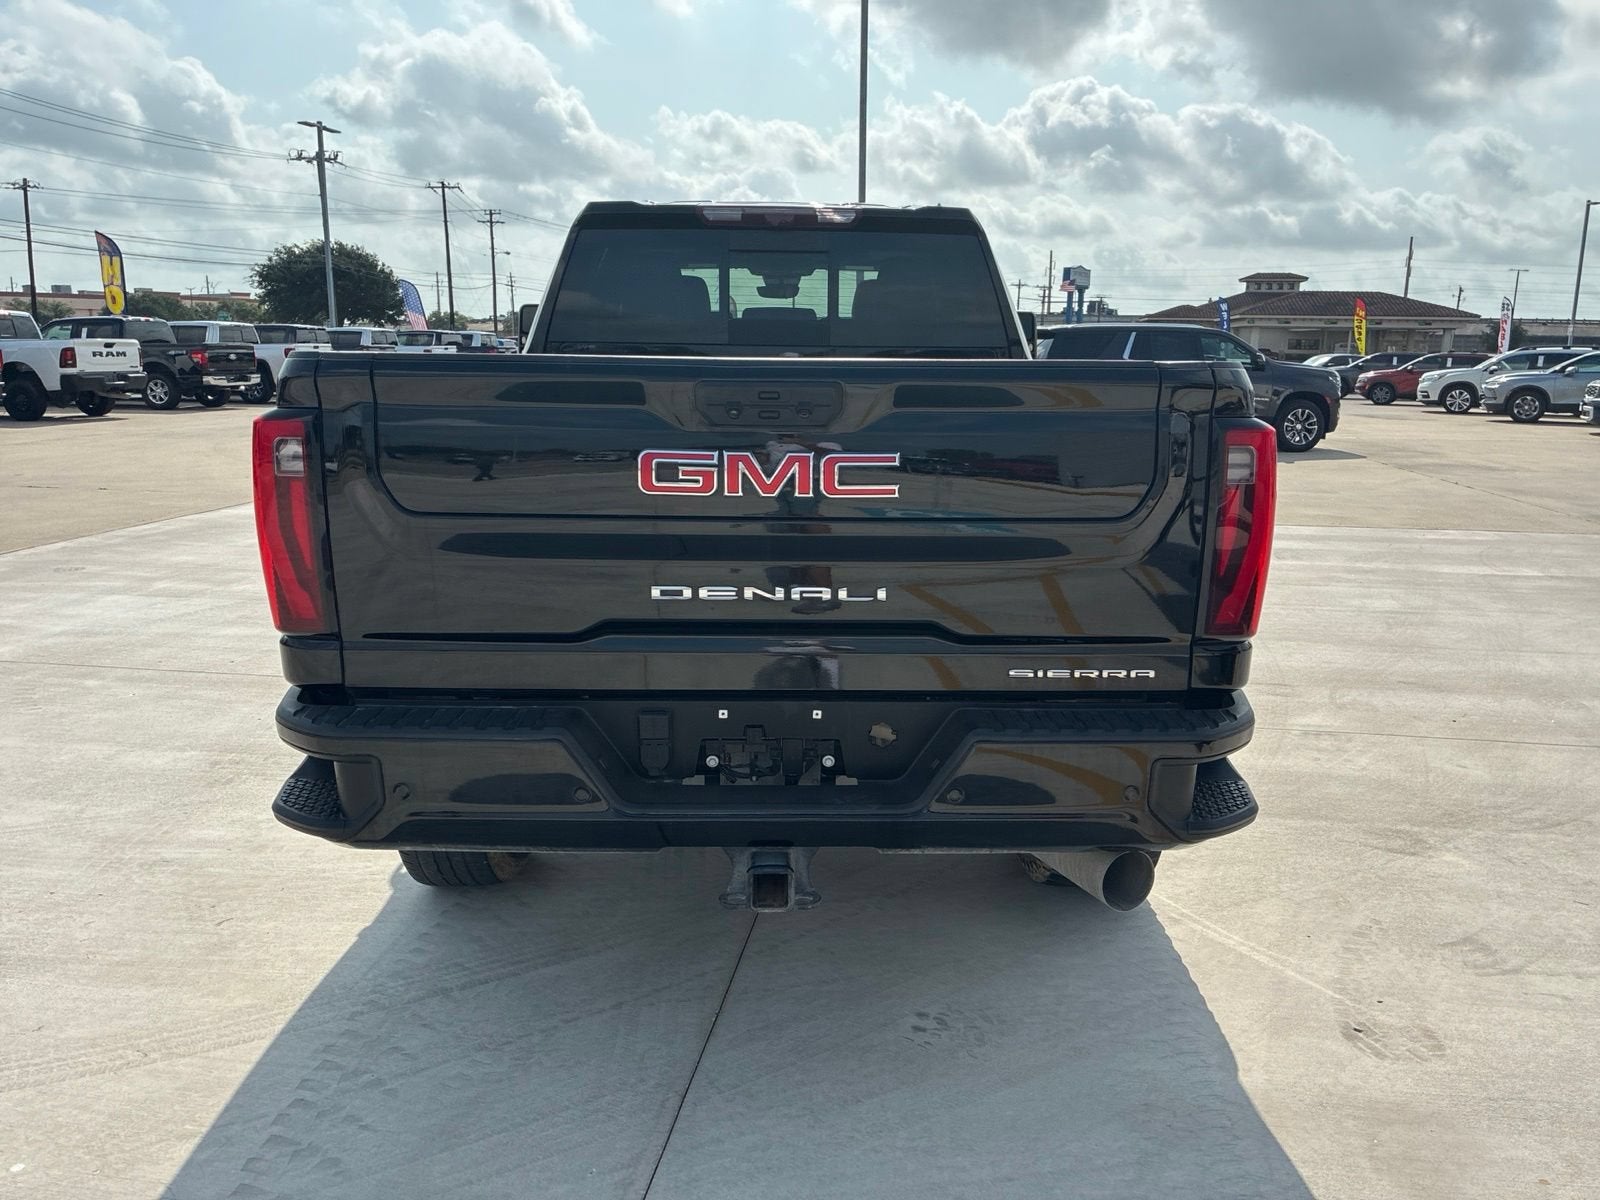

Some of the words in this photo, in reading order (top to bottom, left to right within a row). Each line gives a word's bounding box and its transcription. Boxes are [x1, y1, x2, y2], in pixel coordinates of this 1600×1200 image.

[638, 450, 900, 498] GMC
[651, 586, 887, 601] DENALI
[1008, 669, 1156, 679] SIERRA
